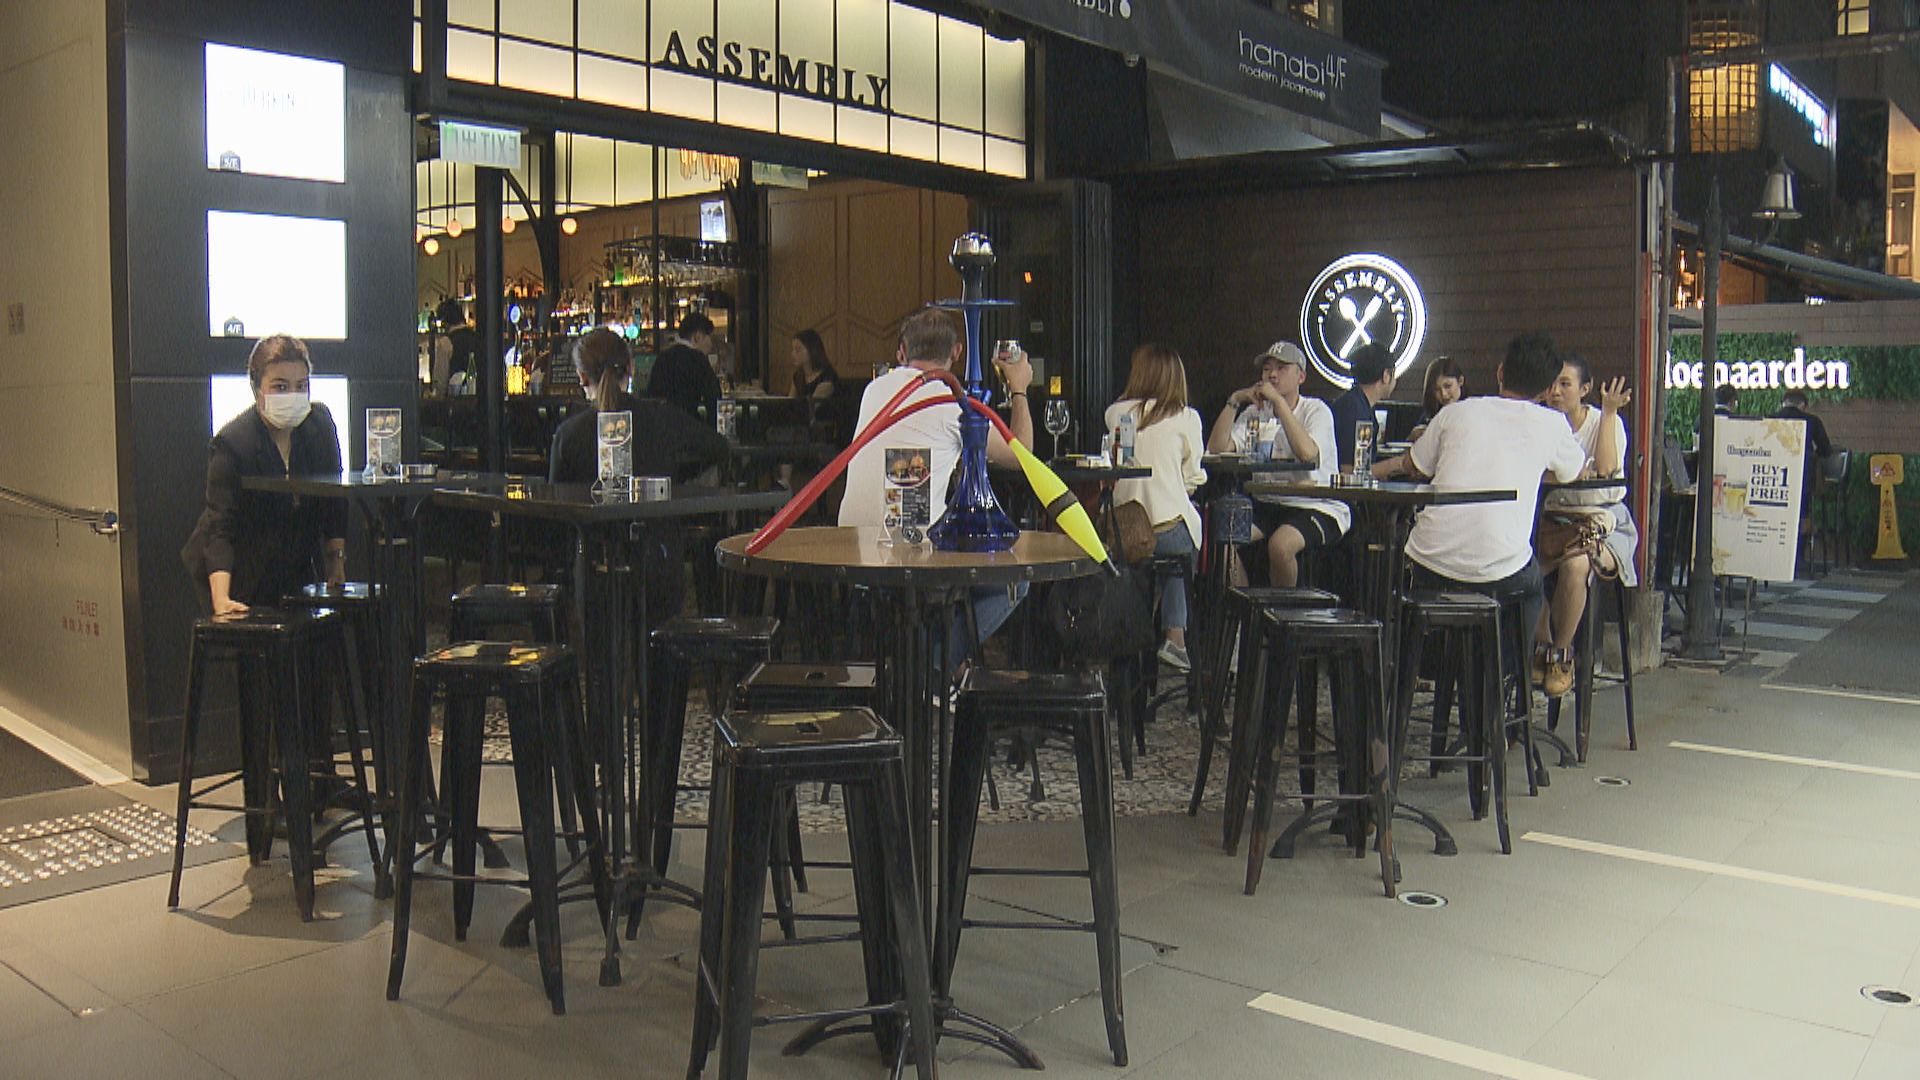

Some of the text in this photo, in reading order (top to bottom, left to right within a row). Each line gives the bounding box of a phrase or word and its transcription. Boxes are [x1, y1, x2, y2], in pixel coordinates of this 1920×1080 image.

[653, 29, 889, 112] ASSEMBLY
[1238, 30, 1348, 91] hanabi 4/F
[1239, 62, 1279, 85] modern
[1318, 270, 1406, 315] ASSEMBLY
[1751, 476, 1778, 488] GET
[1752, 464, 1789, 488] BUY 1
[1750, 488, 1789, 501] FREE
